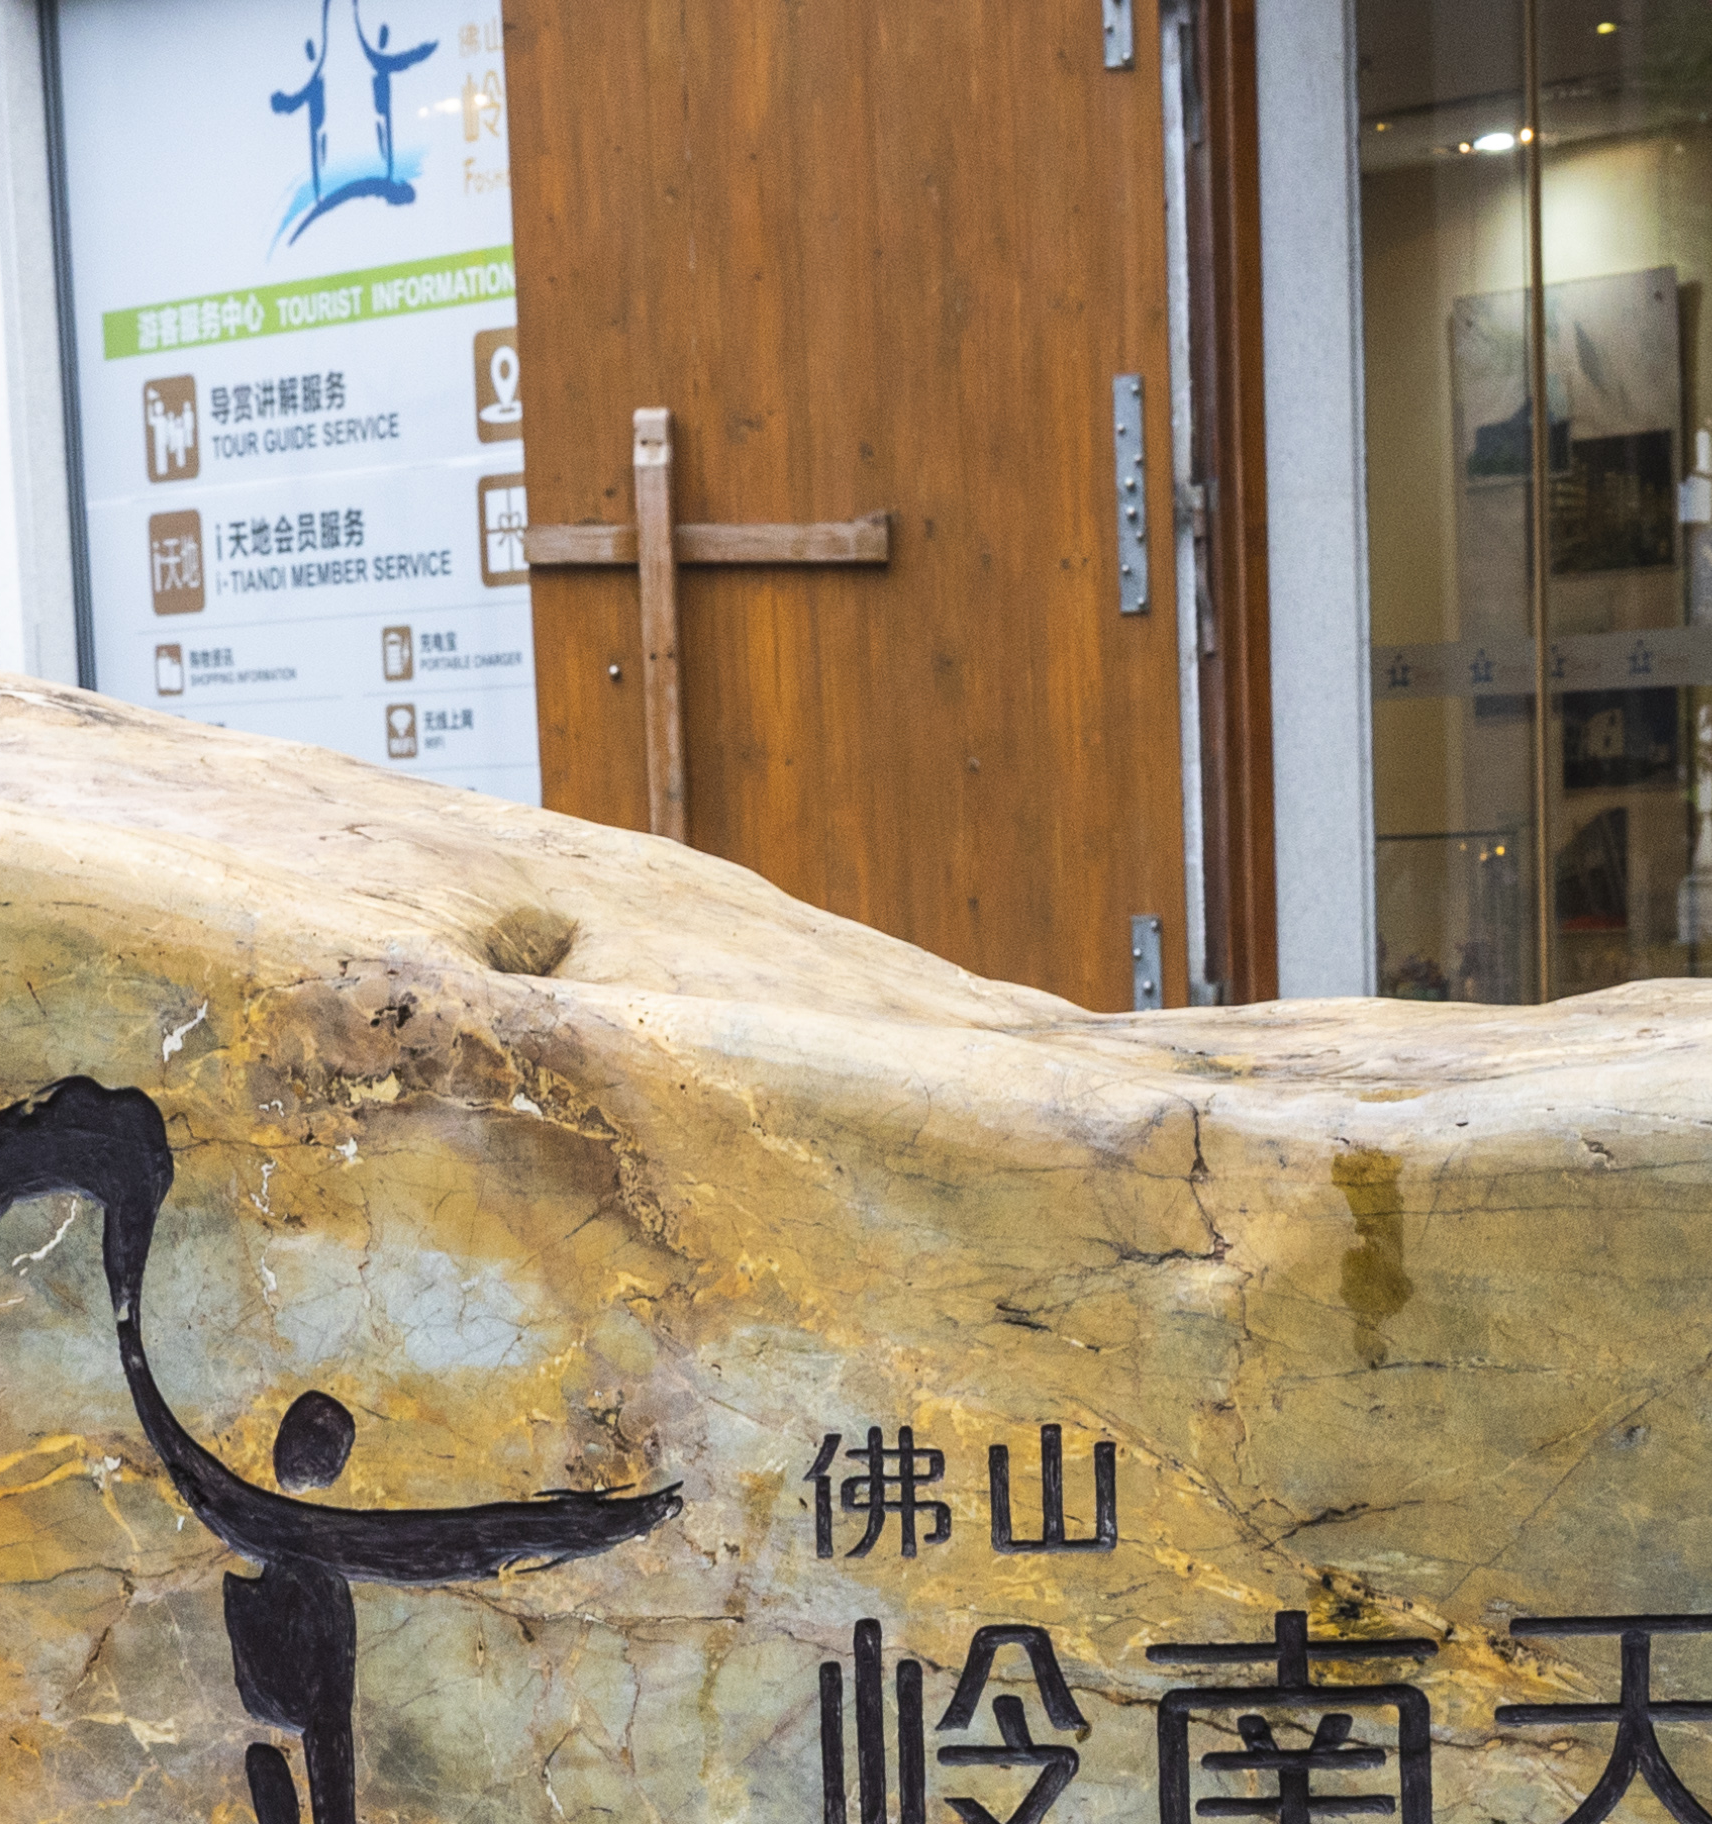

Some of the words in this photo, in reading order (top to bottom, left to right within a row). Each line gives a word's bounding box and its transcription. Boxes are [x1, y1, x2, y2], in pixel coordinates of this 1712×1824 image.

[137, 293, 265, 351] 游客服务中心
[276, 285, 364, 328] TOURIST
[371, 261, 515, 313] INFORMATION
[210, 370, 347, 426] 导赏讲解服务
[211, 429, 261, 461] TOUR
[262, 421, 318, 454] GUIDE
[322, 412, 401, 448] SERVICE
[228, 508, 365, 560] 天地会员服务
[290, 556, 369, 589] MEMBER
[372, 549, 453, 583] SERVICE
[474, 651, 522, 668] CHARGER
[803, 1422, 1117, 1559] 佛山
